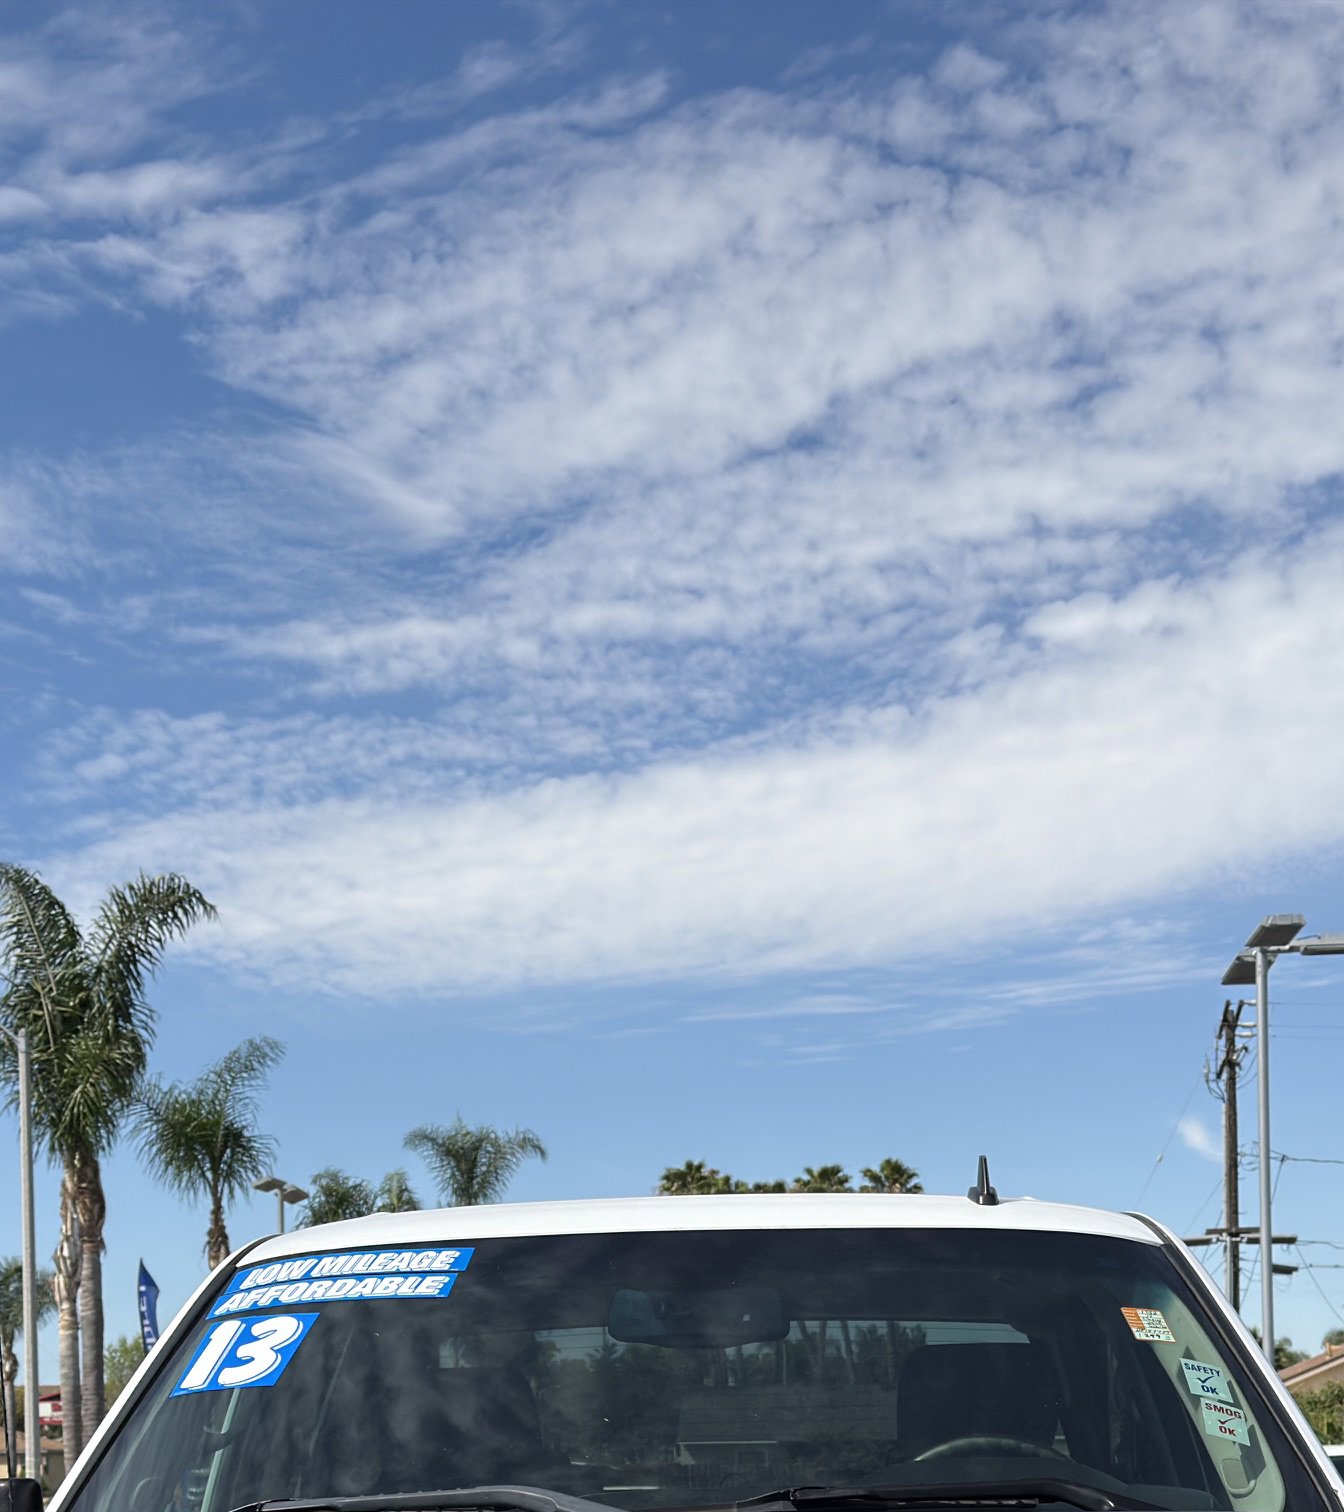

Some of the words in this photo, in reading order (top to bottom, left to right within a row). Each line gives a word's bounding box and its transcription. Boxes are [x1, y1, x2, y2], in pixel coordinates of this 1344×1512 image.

[240, 1258, 315, 1290] LOW
[310, 1250, 460, 1278] MILEAGE
[214, 1275, 450, 1316] AFFORDABLE
[180, 1316, 304, 1391] 13
[1184, 1362, 1220, 1377] SAFETY
[1201, 1385, 1219, 1395] OK
[1205, 1402, 1241, 1419] SMOG
[1219, 1425, 1236, 1436] OK
